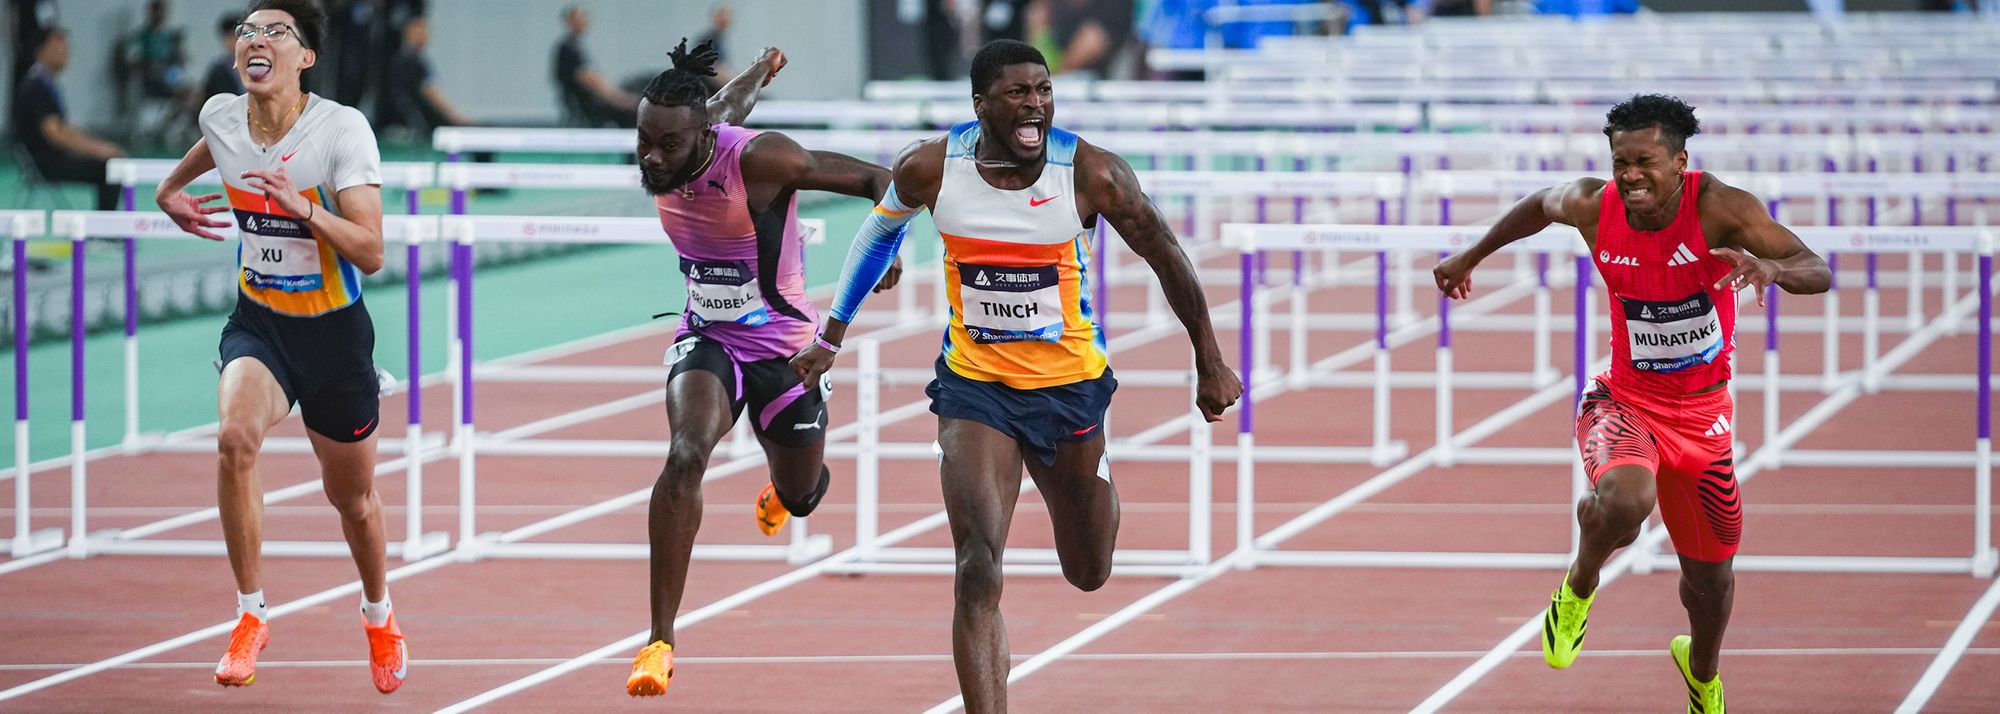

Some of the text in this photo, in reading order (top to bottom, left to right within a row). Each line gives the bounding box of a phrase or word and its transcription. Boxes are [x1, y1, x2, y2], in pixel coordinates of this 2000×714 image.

[261, 247, 283, 262] XU
[1611, 255, 1640, 266] JAL
[980, 301, 1039, 318] TINCH
[1634, 319, 1718, 347] MURATAKE
[1652, 357, 1692, 370] Shanghai
